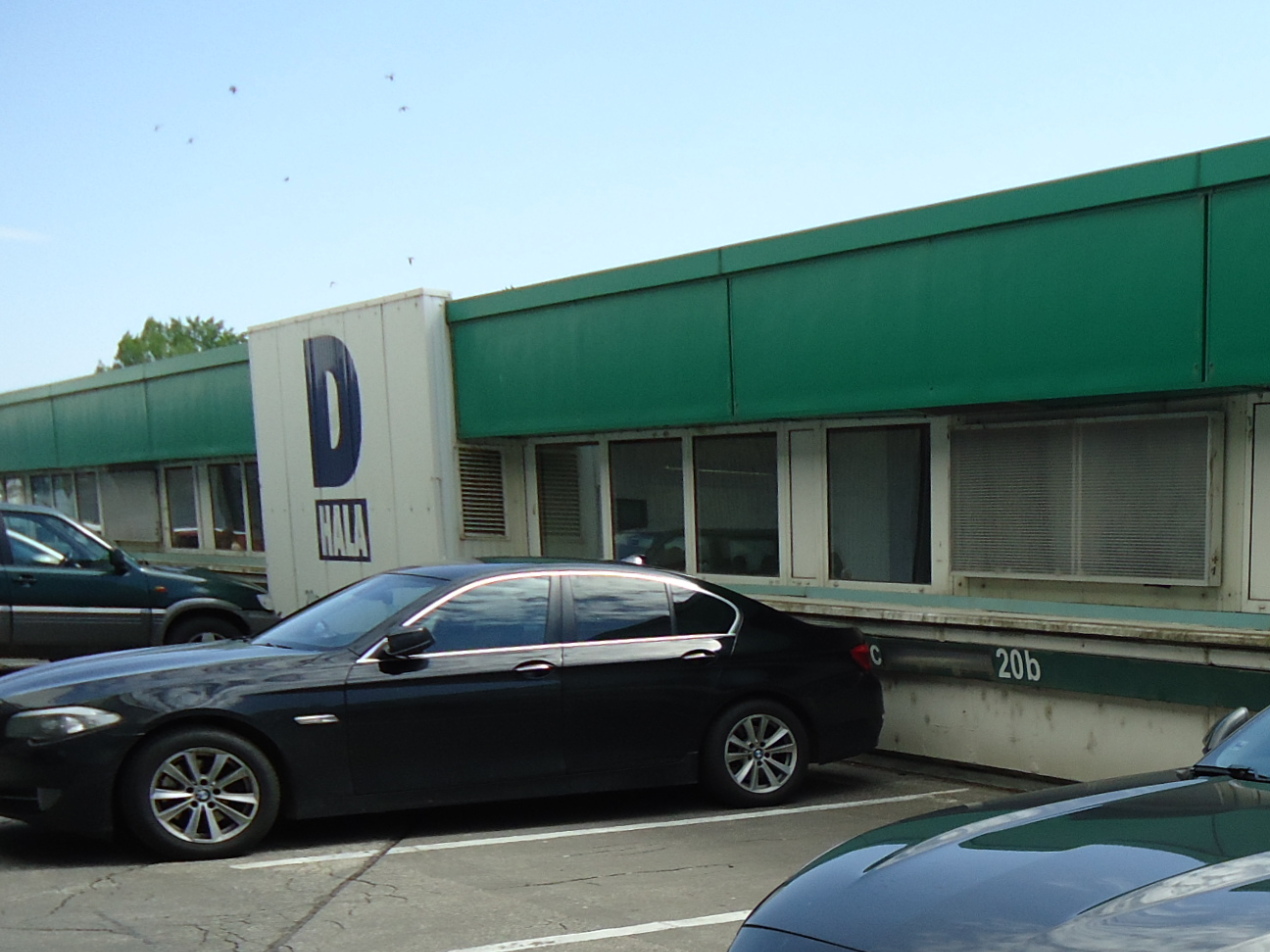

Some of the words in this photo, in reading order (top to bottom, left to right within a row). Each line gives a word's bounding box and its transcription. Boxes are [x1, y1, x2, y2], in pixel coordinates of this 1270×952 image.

[303, 335, 362, 488] D
[318, 503, 368, 557] HALA
[995, 647, 1041, 682] 20b
